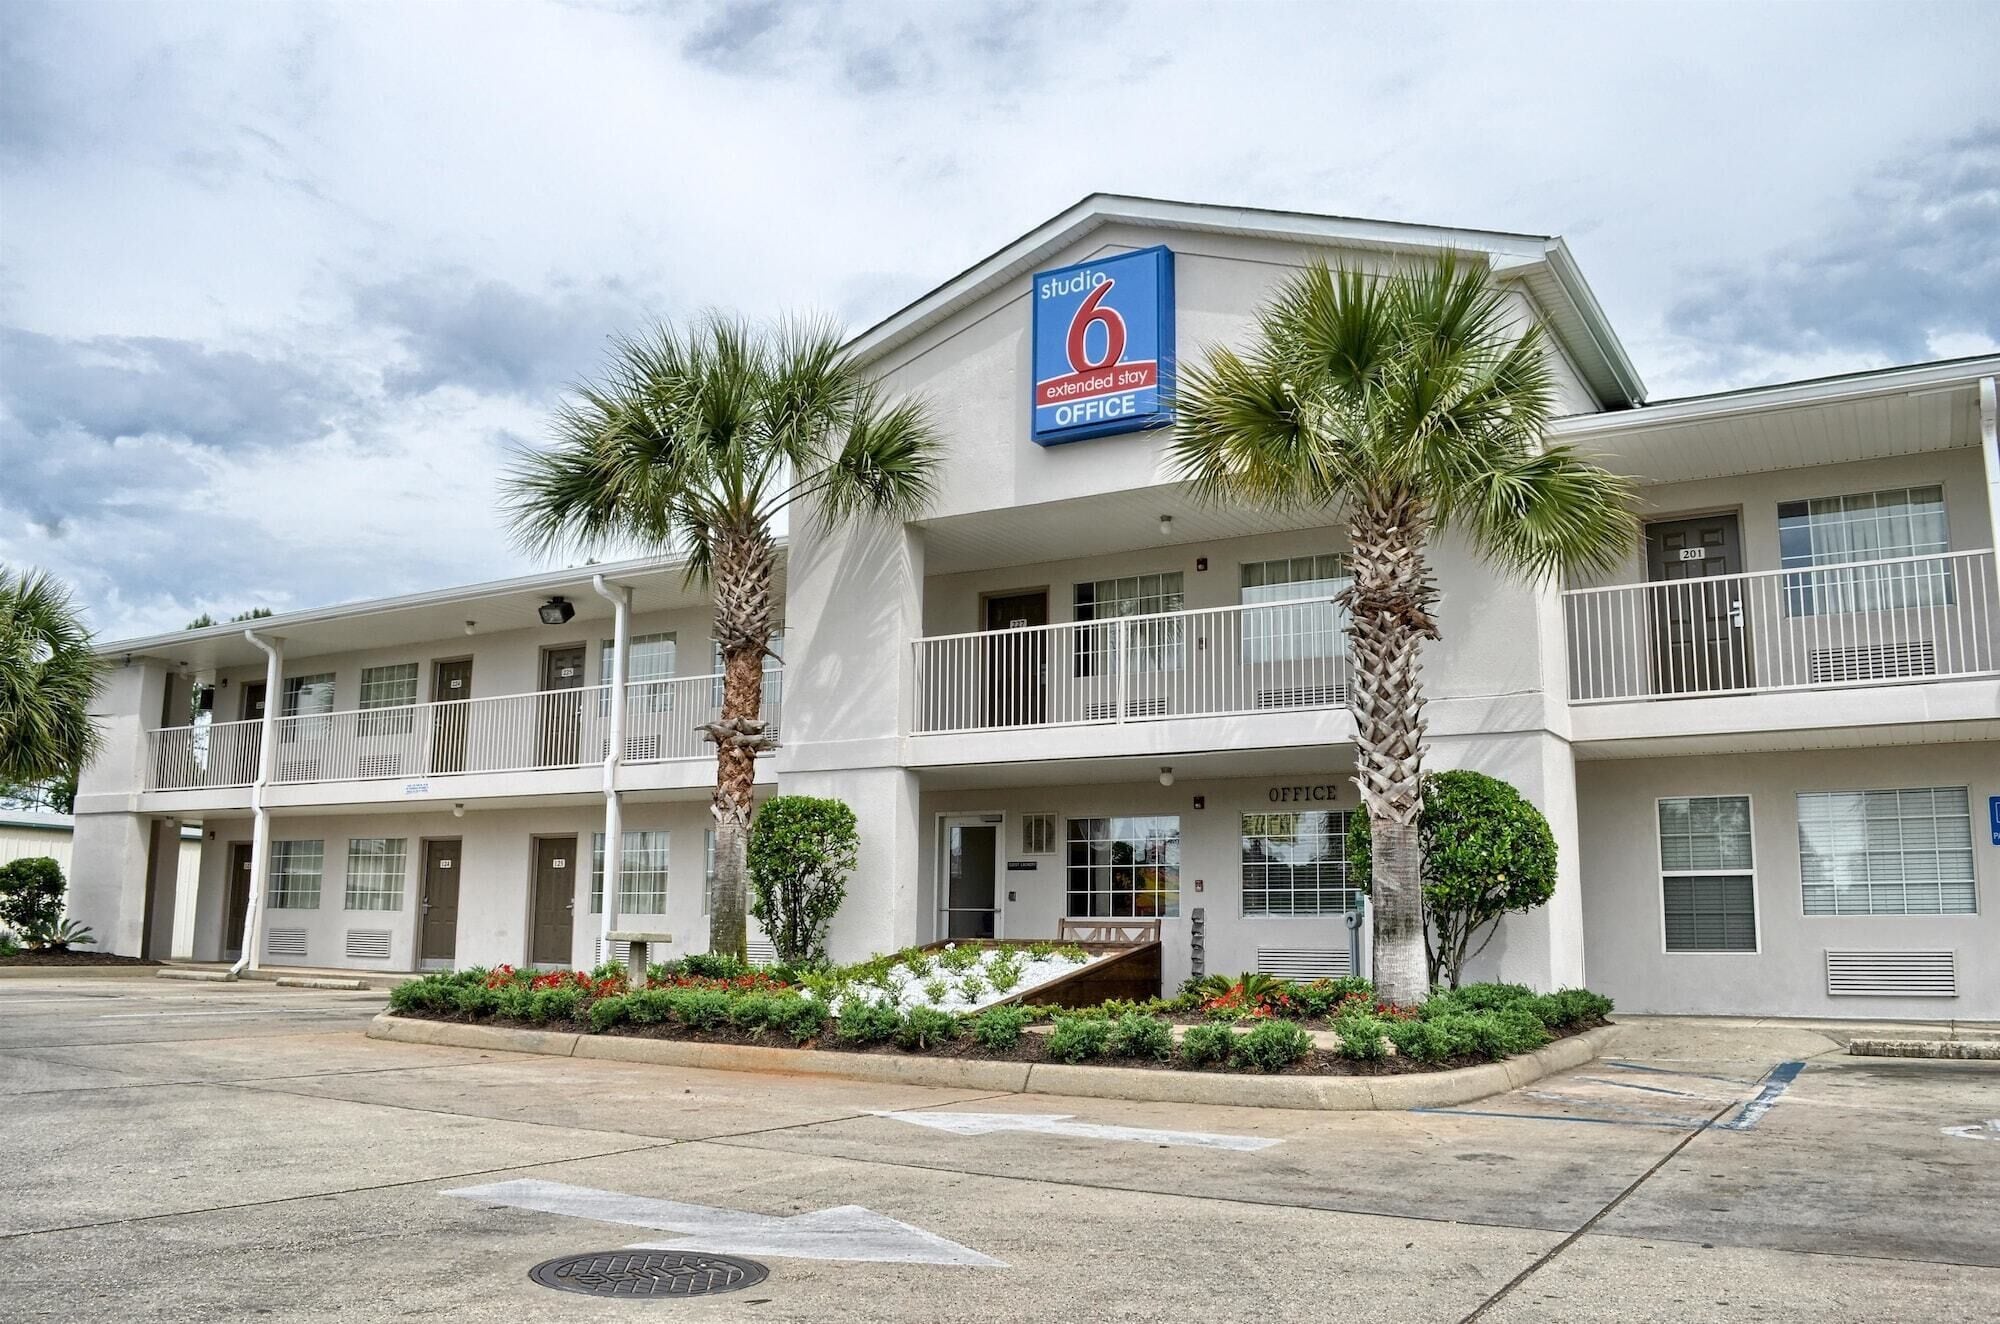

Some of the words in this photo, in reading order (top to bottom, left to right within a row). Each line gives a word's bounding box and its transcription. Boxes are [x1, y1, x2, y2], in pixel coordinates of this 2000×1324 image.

[1041, 270, 1106, 300] studio
[1066, 278, 1127, 374] 6
[1047, 373, 1113, 399] extended
[1118, 369, 1148, 386] stay
[1056, 395, 1135, 426] OFFICE
[1683, 549, 1702, 559] 201
[1269, 785, 1336, 802] OFFICE
